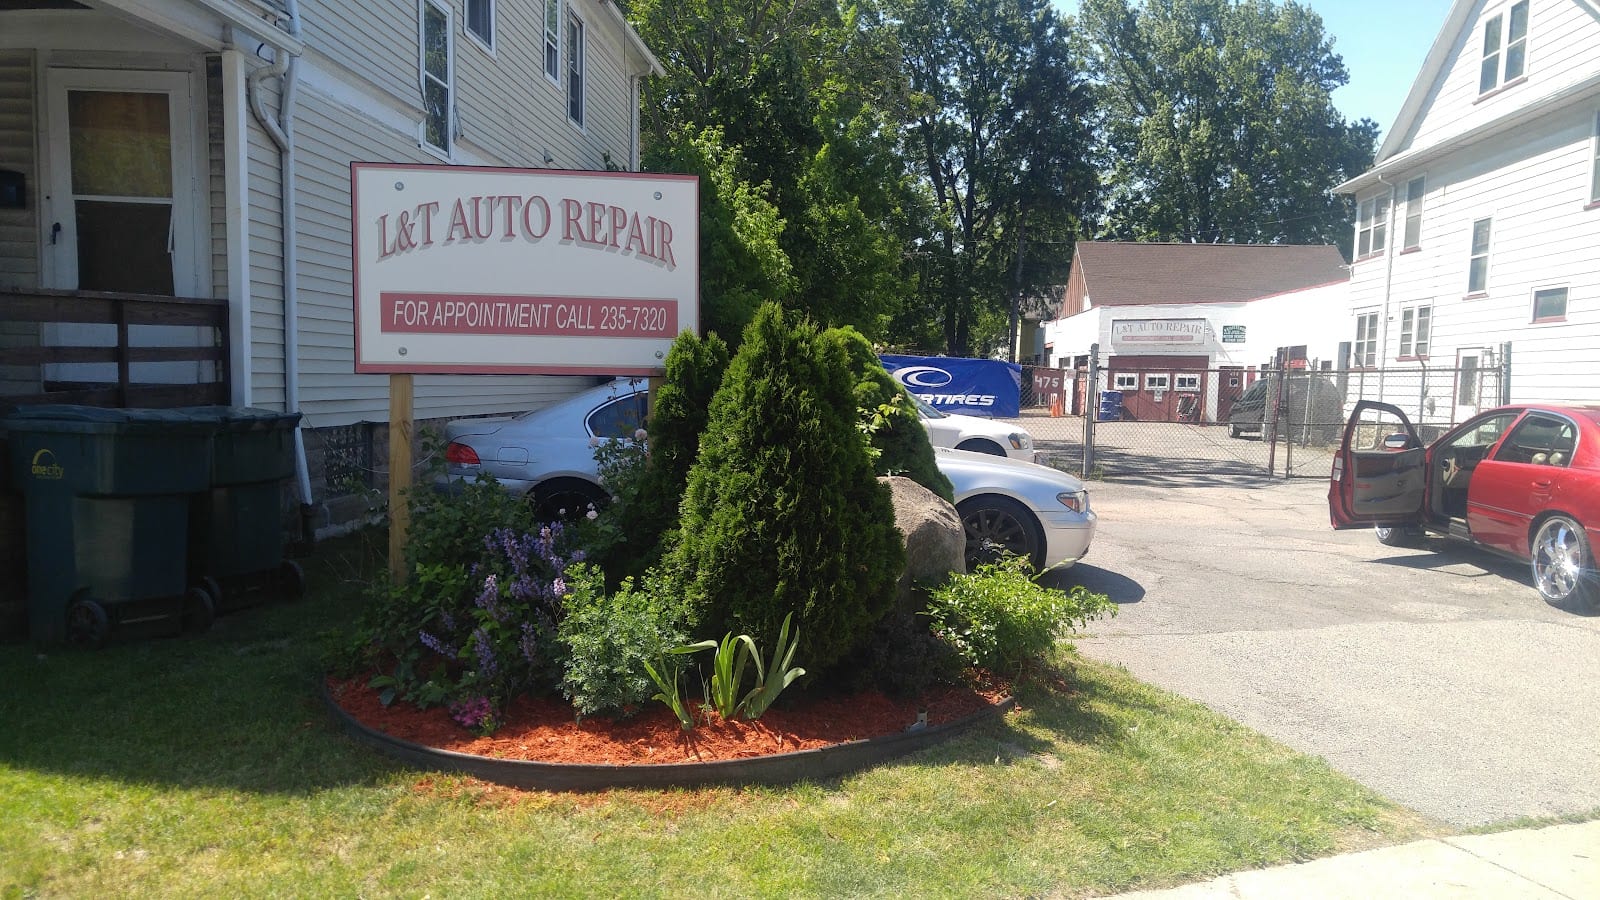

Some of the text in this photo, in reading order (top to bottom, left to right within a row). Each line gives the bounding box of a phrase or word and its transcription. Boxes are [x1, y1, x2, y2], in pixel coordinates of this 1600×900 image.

[378, 195, 678, 269] L&T AUTO REPAIR
[393, 300, 667, 332] FOR APPOINTMENT CALL 235-7320
[1116, 322, 1202, 335] L&T AUTO REPAIR
[1034, 375, 1060, 389] 475
